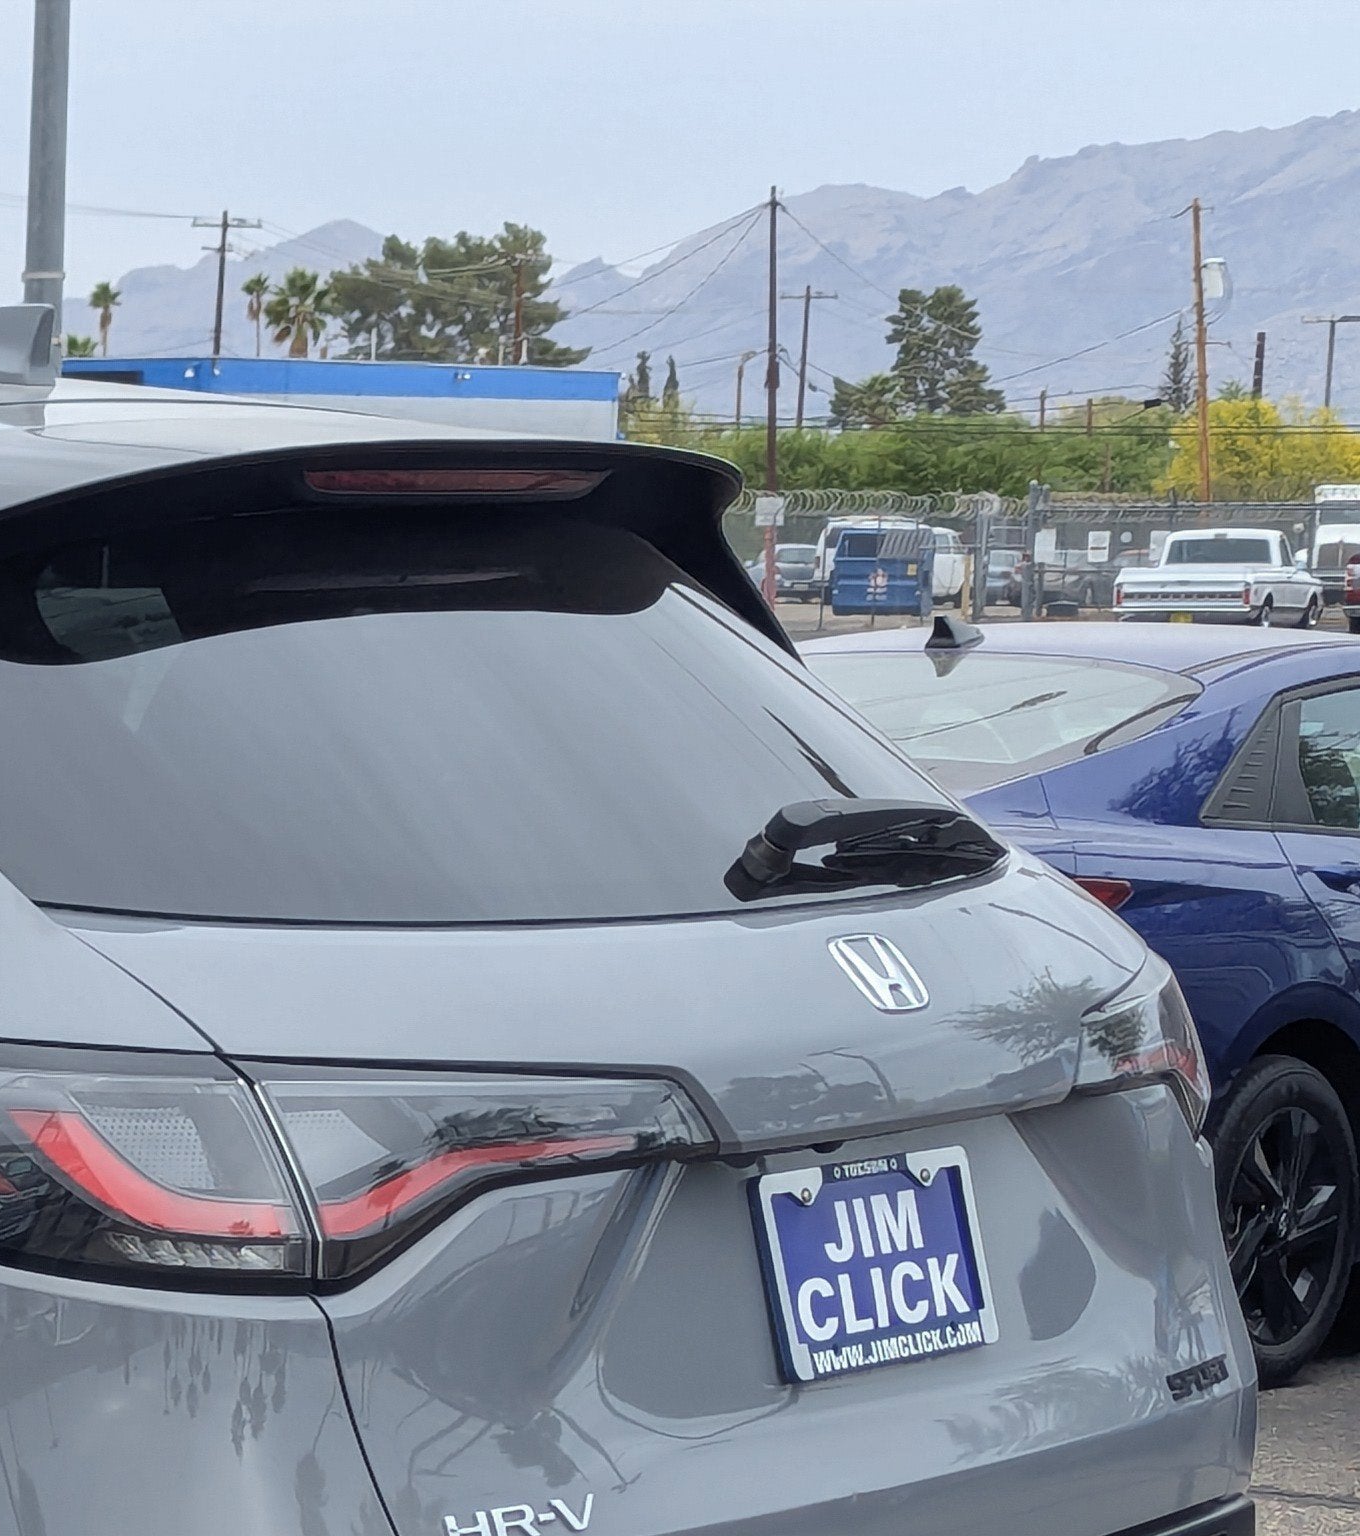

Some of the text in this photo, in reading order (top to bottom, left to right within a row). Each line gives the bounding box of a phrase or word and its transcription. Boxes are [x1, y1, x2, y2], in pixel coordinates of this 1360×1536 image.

[823, 1188, 925, 1263] JIM
[797, 1253, 971, 1342] CLICK
[812, 1320, 983, 1374] WWW.JIMCLICK.COM
